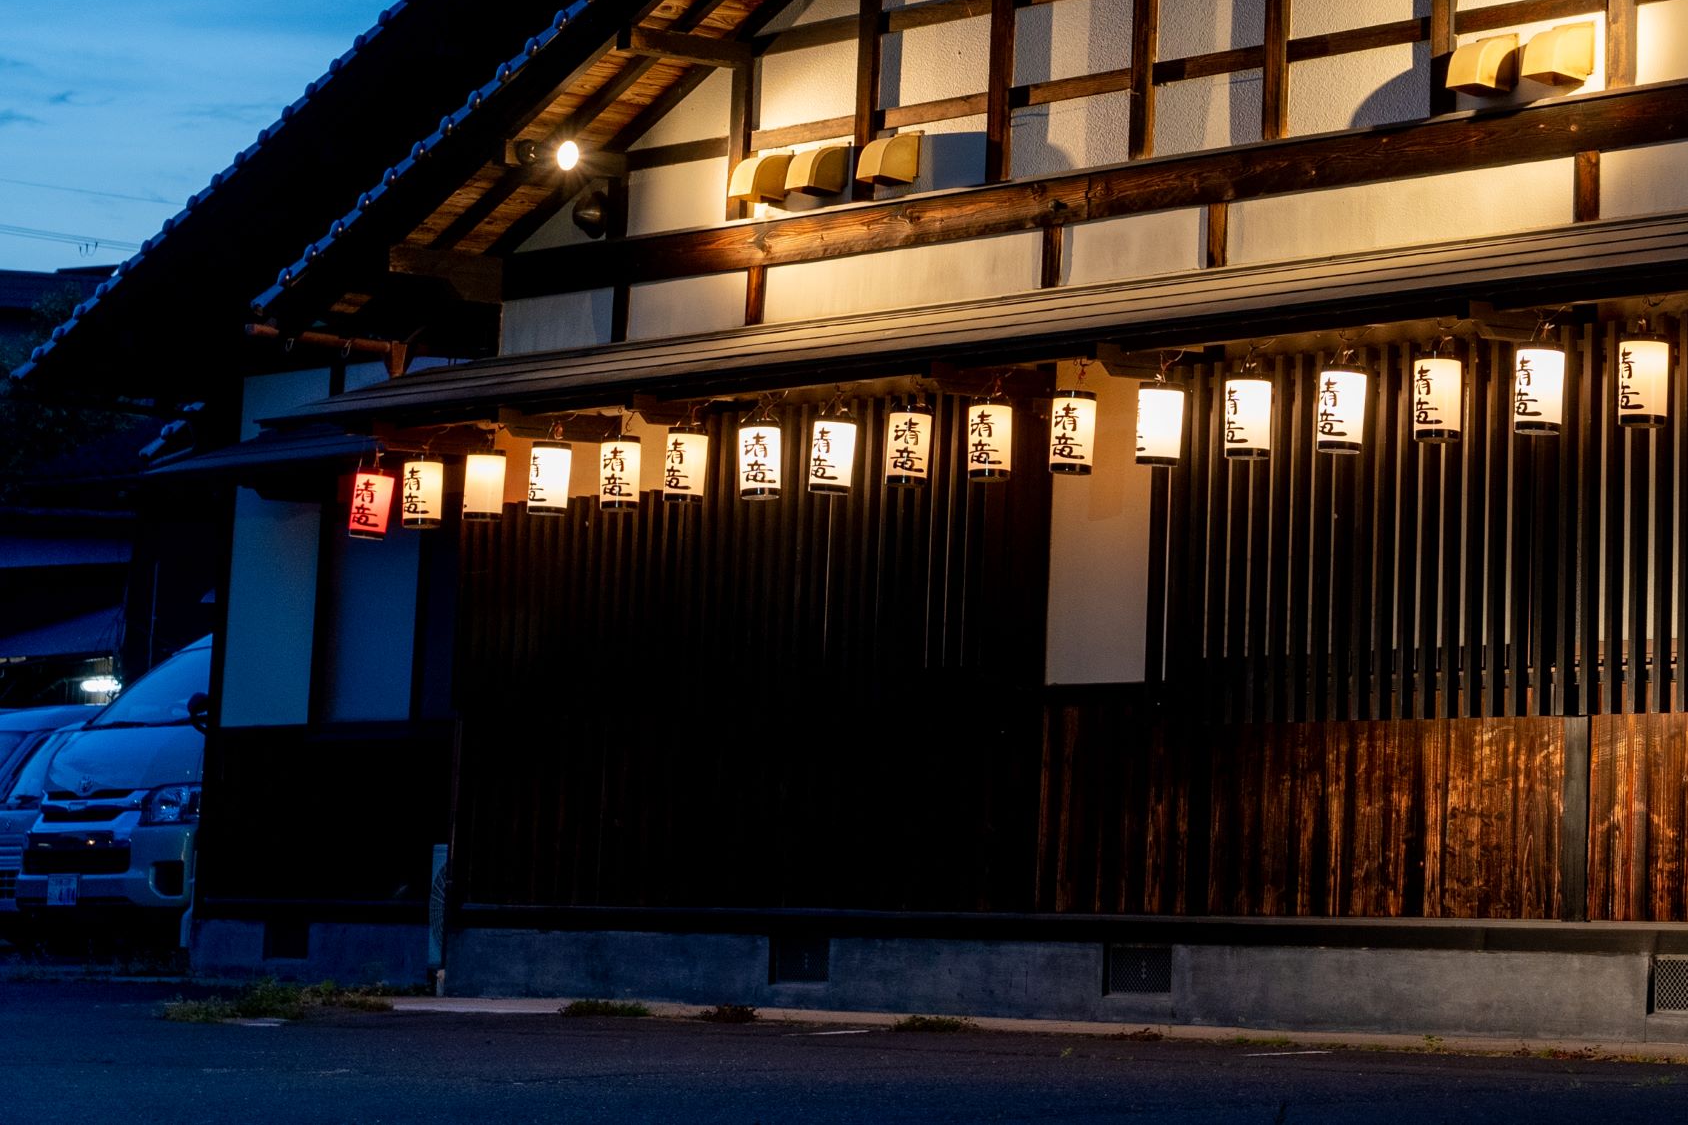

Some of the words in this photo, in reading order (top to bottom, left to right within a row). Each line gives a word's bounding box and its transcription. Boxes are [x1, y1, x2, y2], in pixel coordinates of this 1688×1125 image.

[742, 431, 776, 484] 清竜
[890, 417, 925, 473] 清竜
[1051, 402, 1085, 459] 清竜
[601, 446, 633, 497] 清竜
